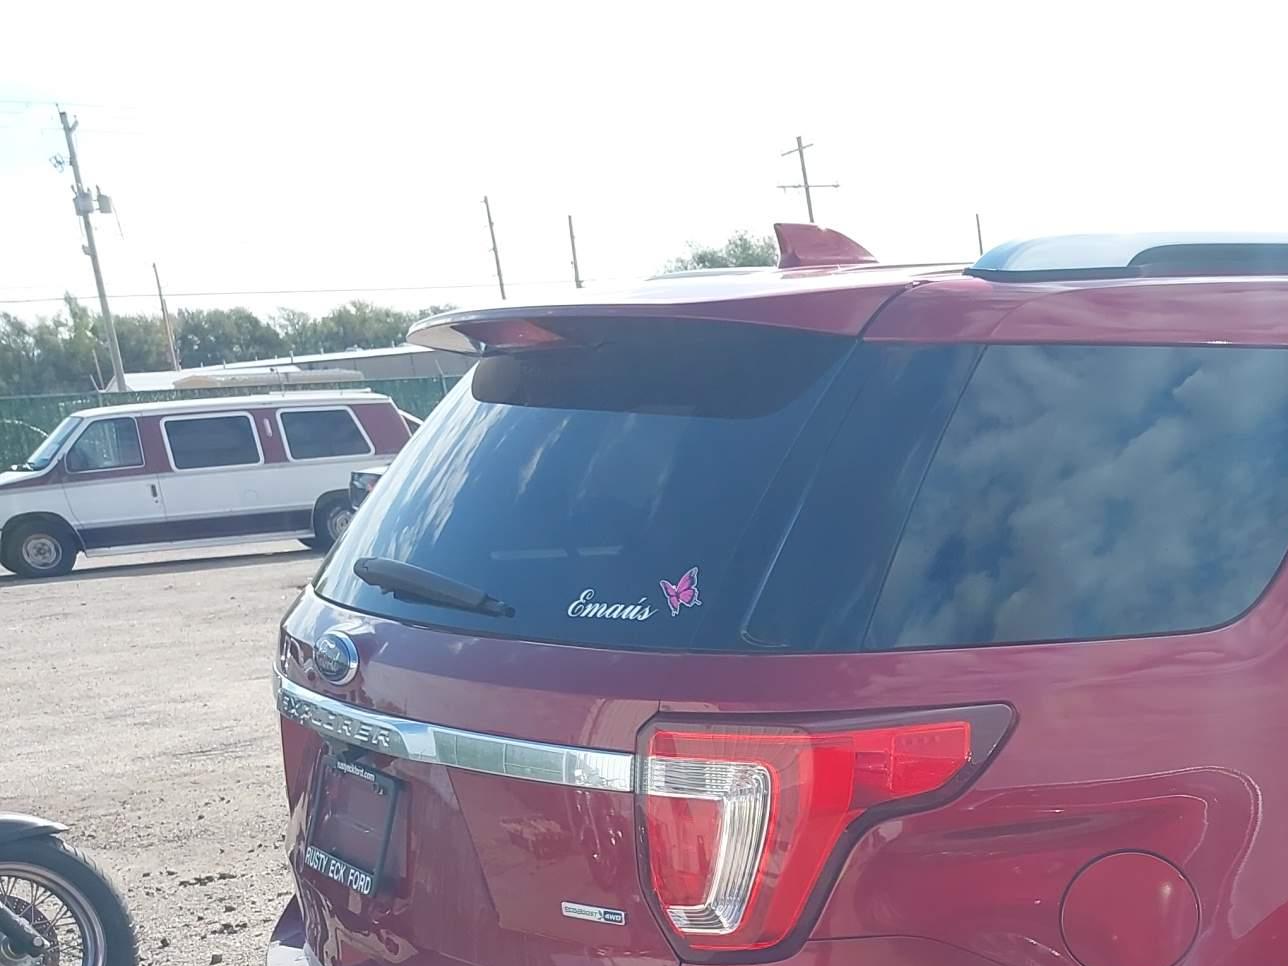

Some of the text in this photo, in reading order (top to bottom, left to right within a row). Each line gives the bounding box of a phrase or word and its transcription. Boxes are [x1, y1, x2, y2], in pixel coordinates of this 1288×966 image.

[567, 588, 658, 621] Emaús
[281, 695, 391, 747] EXPLORER
[304, 846, 373, 895] RUSTY ECK FORD
[604, 912, 622, 921] 4WD
